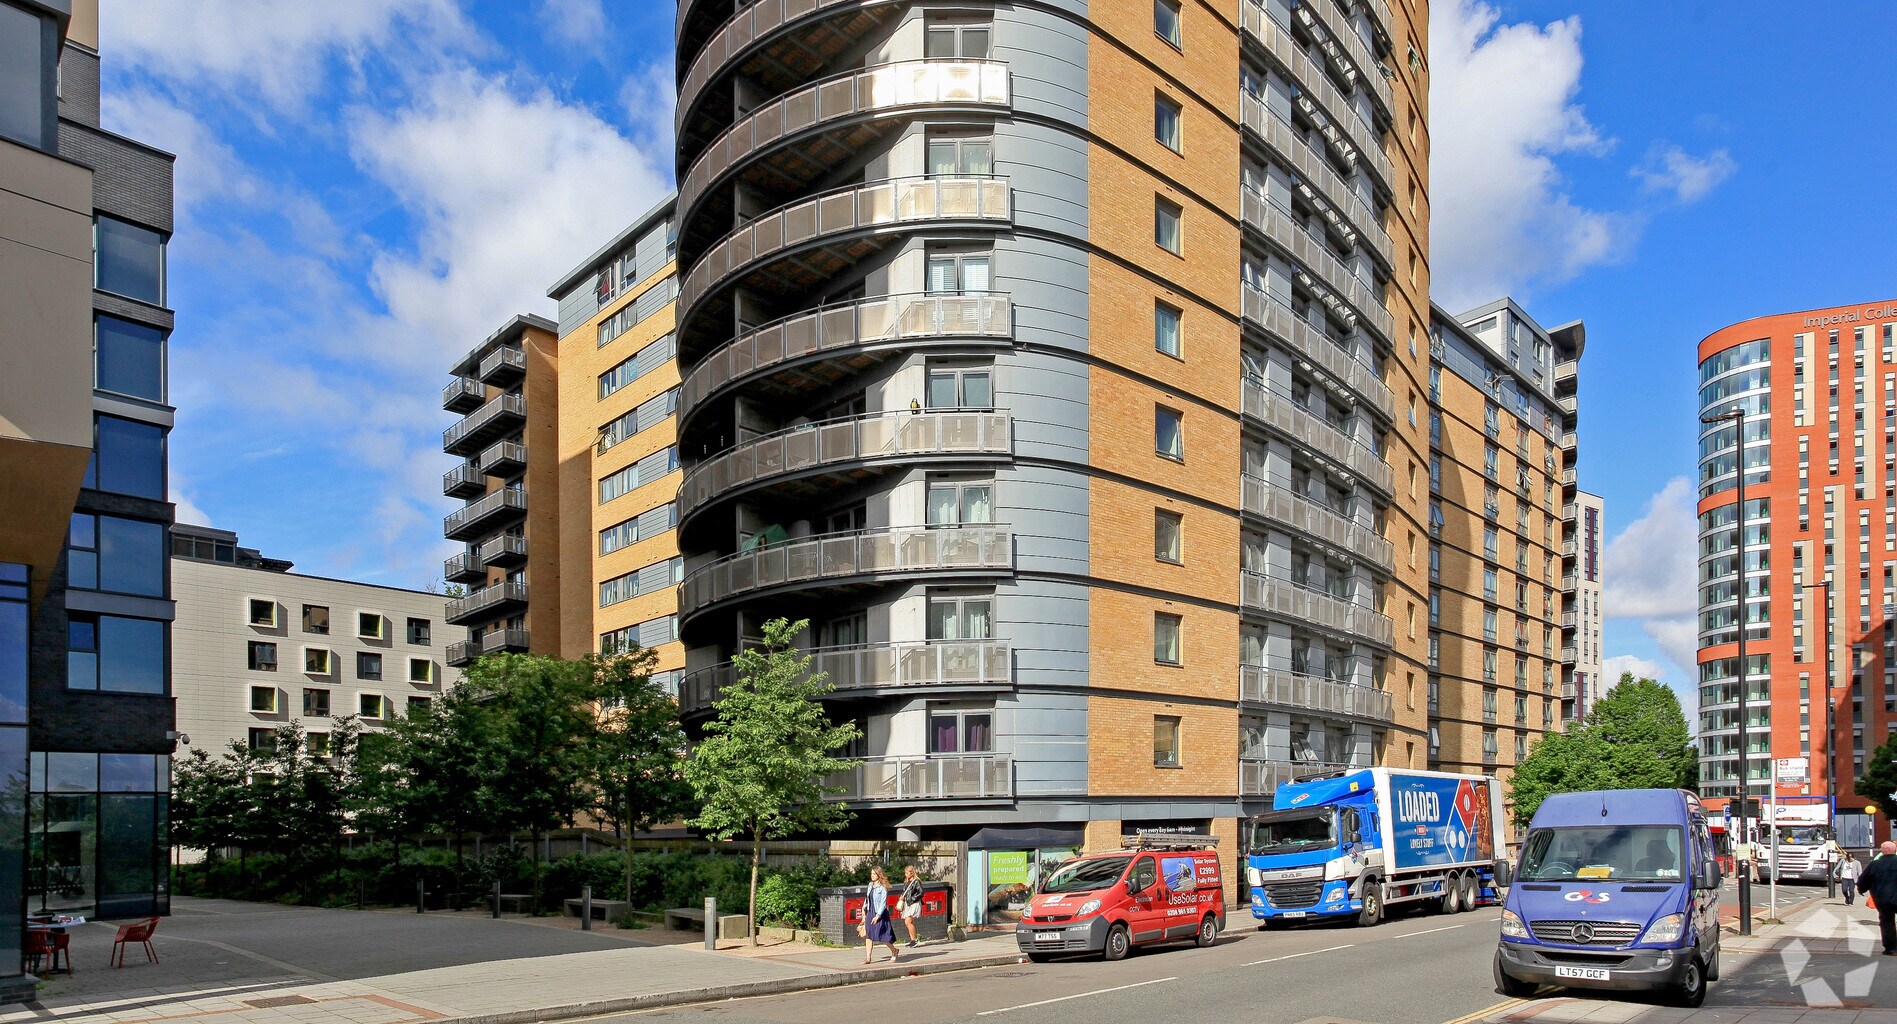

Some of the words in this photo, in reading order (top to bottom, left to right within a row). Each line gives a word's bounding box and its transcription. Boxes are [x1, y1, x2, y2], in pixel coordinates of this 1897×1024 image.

[1804, 310, 1860, 329] Imperial
[1398, 790, 1440, 823] LOADED
[993, 856, 1025, 865] Freshly
[993, 866, 1025, 874] prepared
[1168, 892, 1214, 905] UseSolar.co.uk
[1564, 890, 1610, 903] G4S
[1559, 967, 1584, 977] LT57
[1586, 969, 1606, 978] GCF
